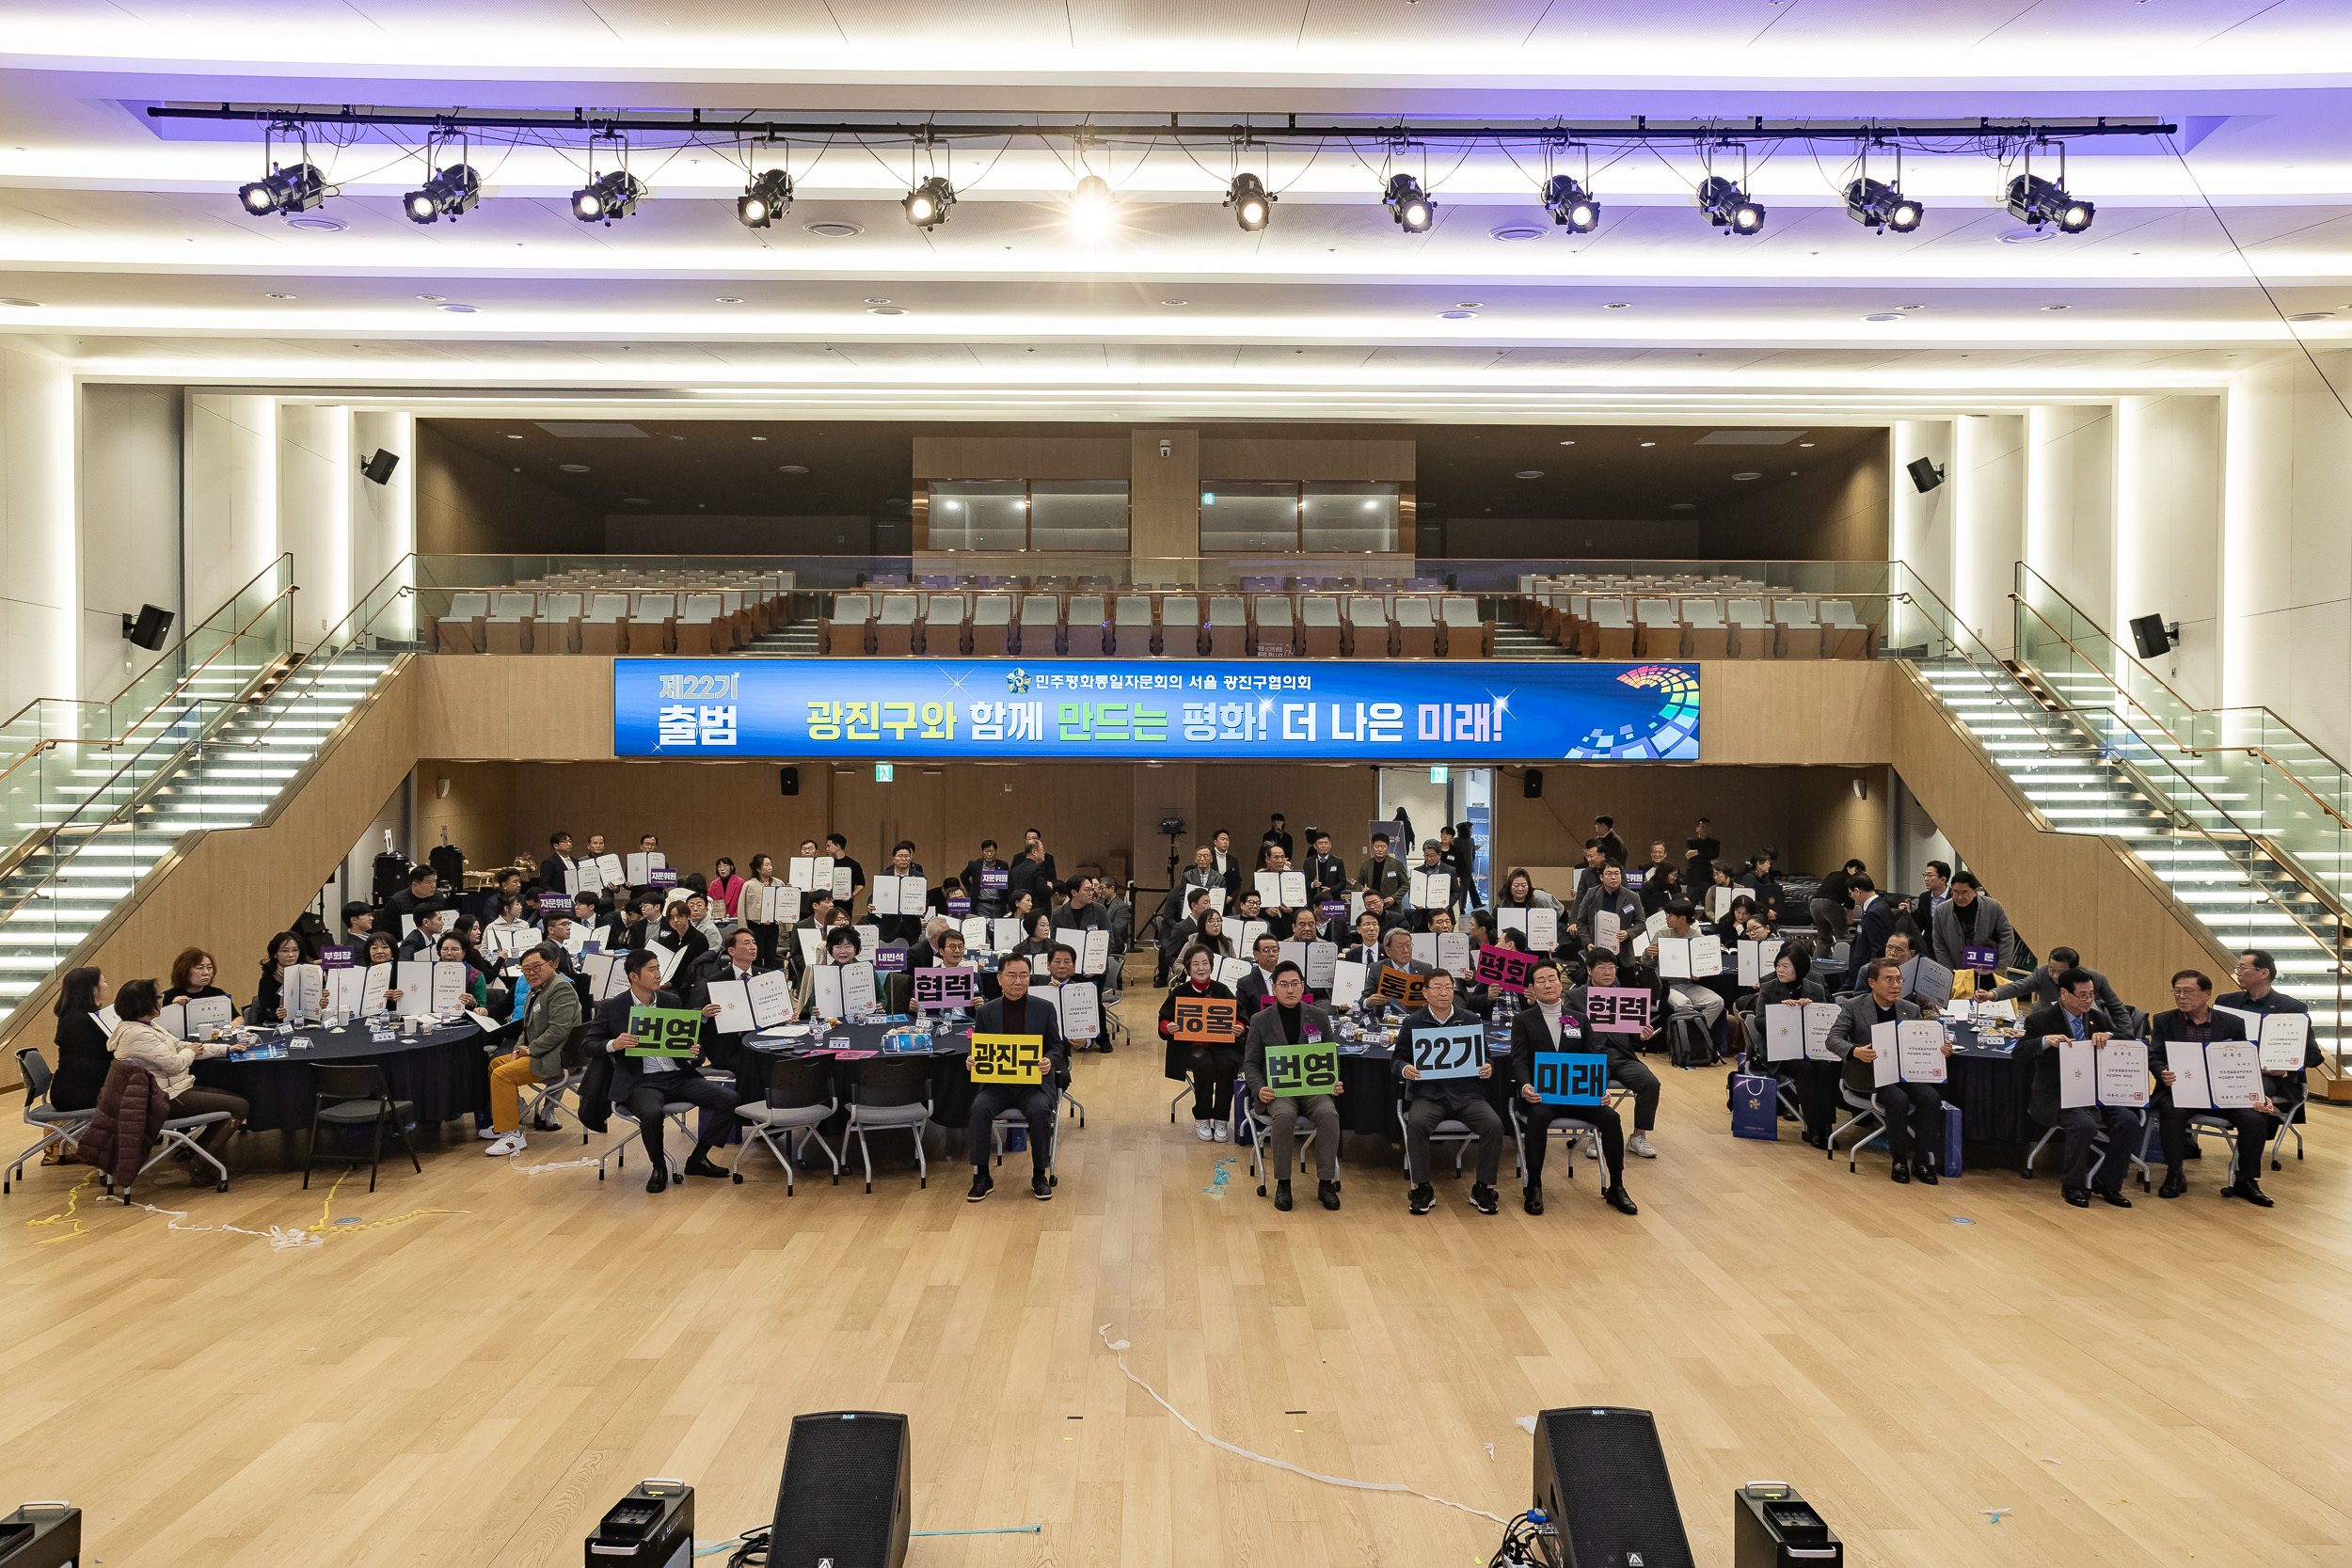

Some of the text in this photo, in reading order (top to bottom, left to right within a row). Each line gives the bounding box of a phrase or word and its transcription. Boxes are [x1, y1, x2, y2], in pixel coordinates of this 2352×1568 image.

[659, 674, 739, 700] 제22기
[1035, 674, 1311, 690] 민주평화통일자문회의 서울 광진구협의회
[659, 704, 738, 746] 출범
[806, 701, 1502, 742] 광진구와 함께 만드는 평화! 더 나은 미래!
[651, 871, 676, 880] 자문위원
[982, 874, 1009, 882] 자문위원
[540, 898, 572, 909] 자문위원
[324, 951, 351, 960] 부회장
[878, 952, 904, 962] 내빈석
[915, 974, 972, 1003] 협력
[1588, 995, 1647, 1026] 협력
[630, 1016, 696, 1051] 번영
[974, 1043, 1041, 1077] 광진구
[1414, 1034, 1484, 1071] 22기
[1268, 1052, 1336, 1089] 번영
[1537, 1063, 1604, 1098] 미래
